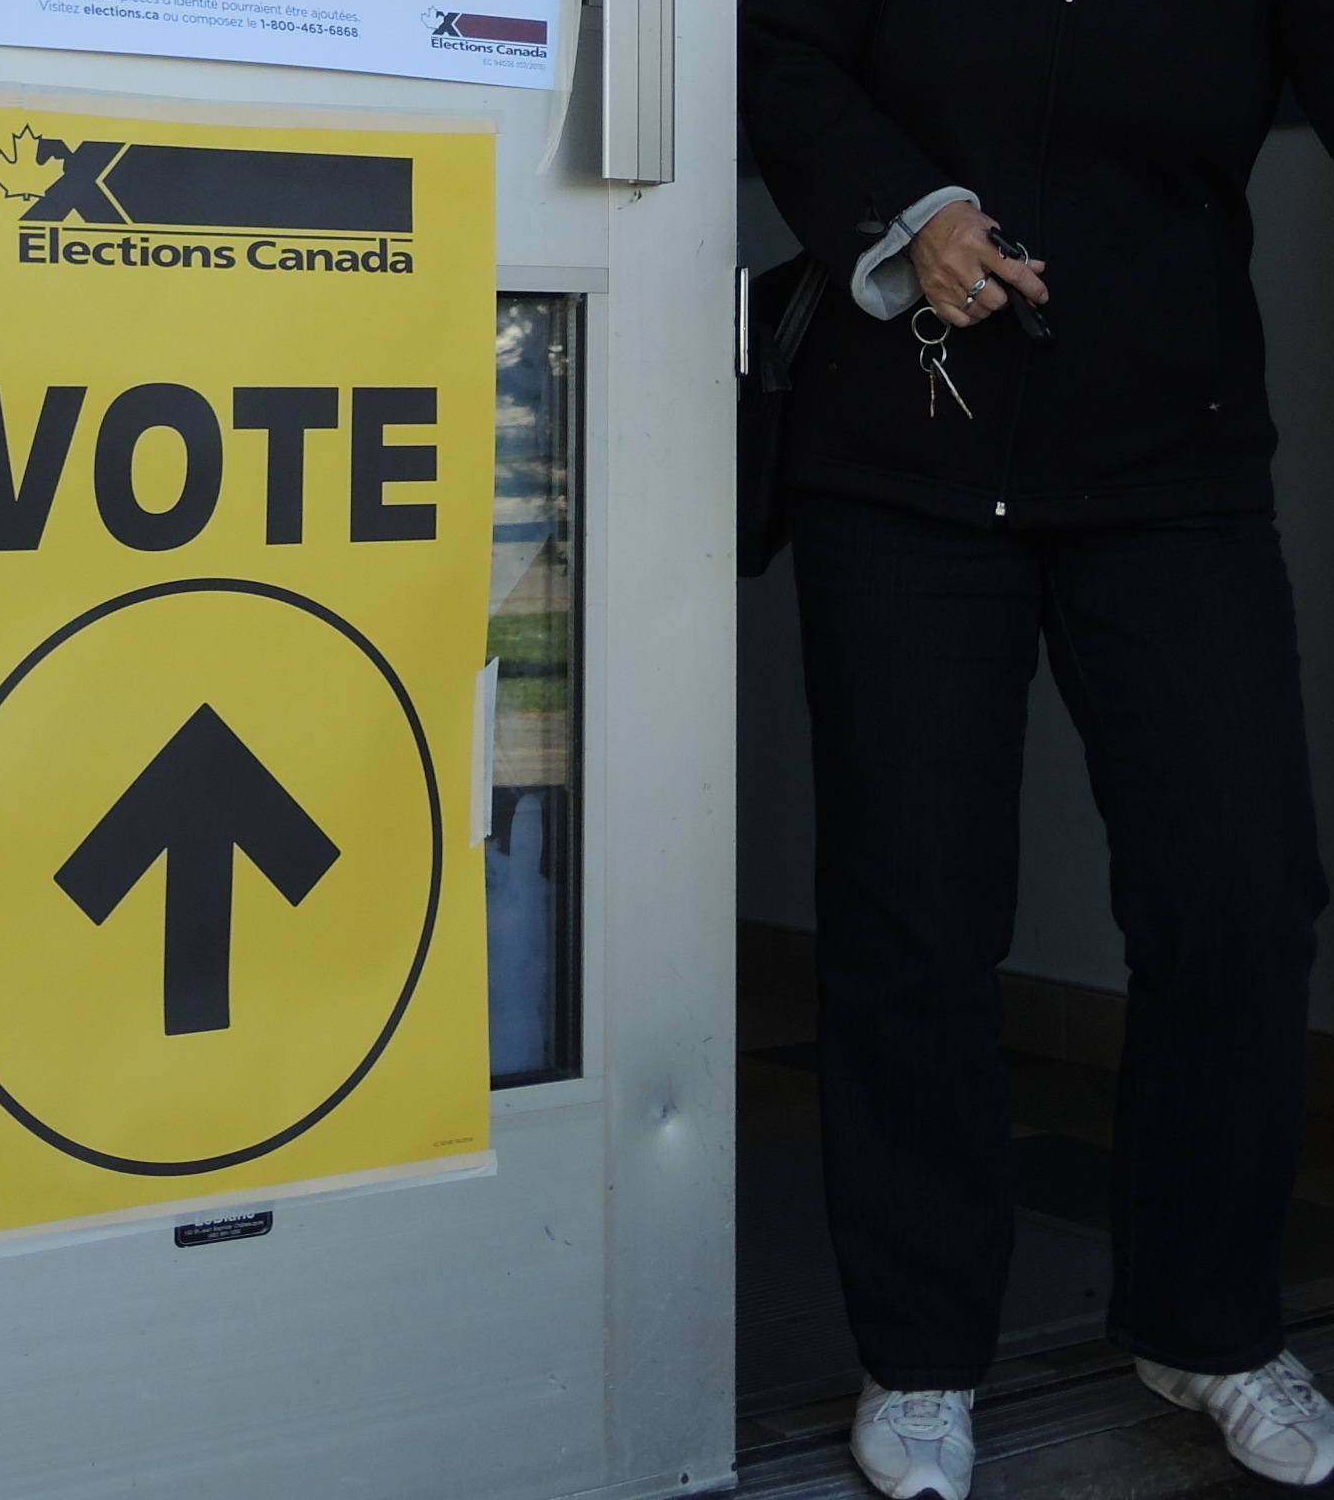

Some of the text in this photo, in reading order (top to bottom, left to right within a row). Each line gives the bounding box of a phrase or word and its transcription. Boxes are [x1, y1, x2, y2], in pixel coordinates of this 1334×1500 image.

[39, 0, 361, 38] Visitez elections.ca ou composez le 1-800-463-6868.
[430, 37, 547, 59] Elections Canada
[18, 230, 414, 274] Elections Canada
